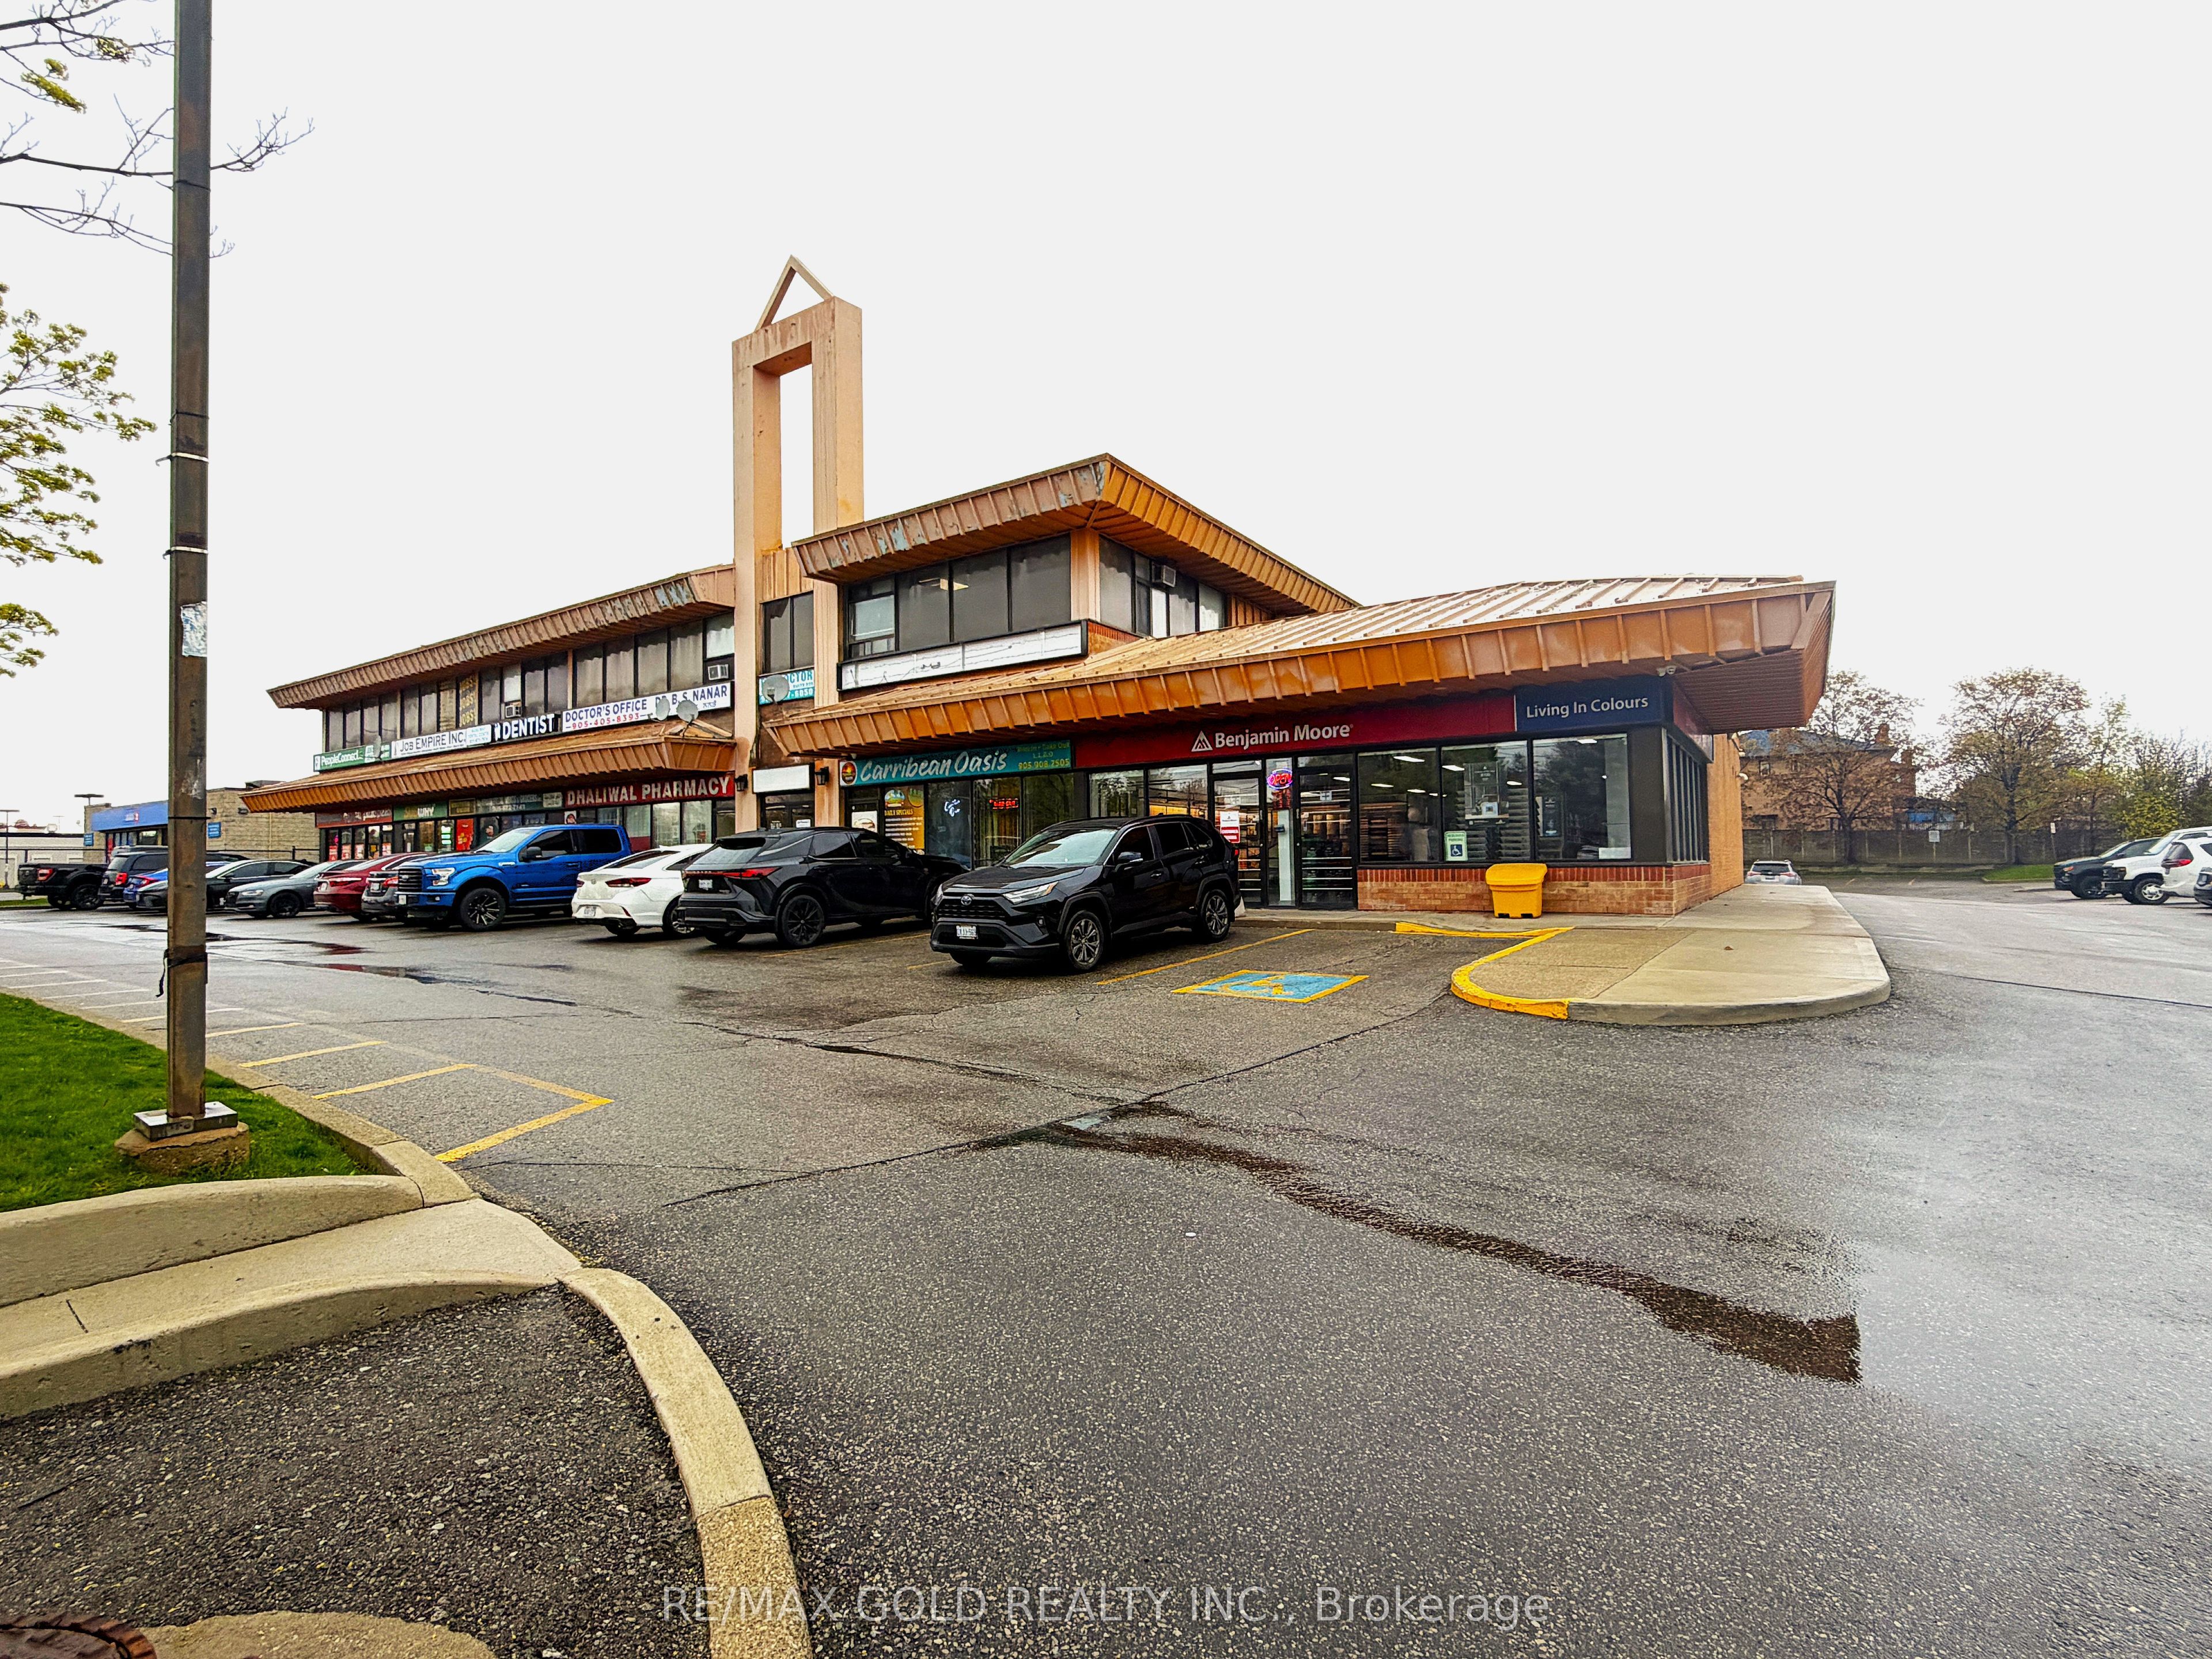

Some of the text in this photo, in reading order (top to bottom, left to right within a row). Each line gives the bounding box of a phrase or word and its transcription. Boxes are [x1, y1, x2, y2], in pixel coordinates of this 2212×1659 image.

[785, 670, 813, 684] CTOR
[566, 705, 611, 722] DOCTOR'S
[612, 699, 647, 715] OFFICE
[693, 684, 728, 702] NANAR
[1527, 697, 1649, 718] Living In Colours
[502, 713, 555, 740] DENTIST
[1215, 724, 1350, 750] Benjamin Moore
[400, 741, 414, 752] JOB
[415, 734, 446, 749] EMPIRE
[860, 751, 1007, 782] Carribean Oasis
[567, 785, 638, 805] DHALIWAL
[641, 777, 730, 800] PHARMACY
